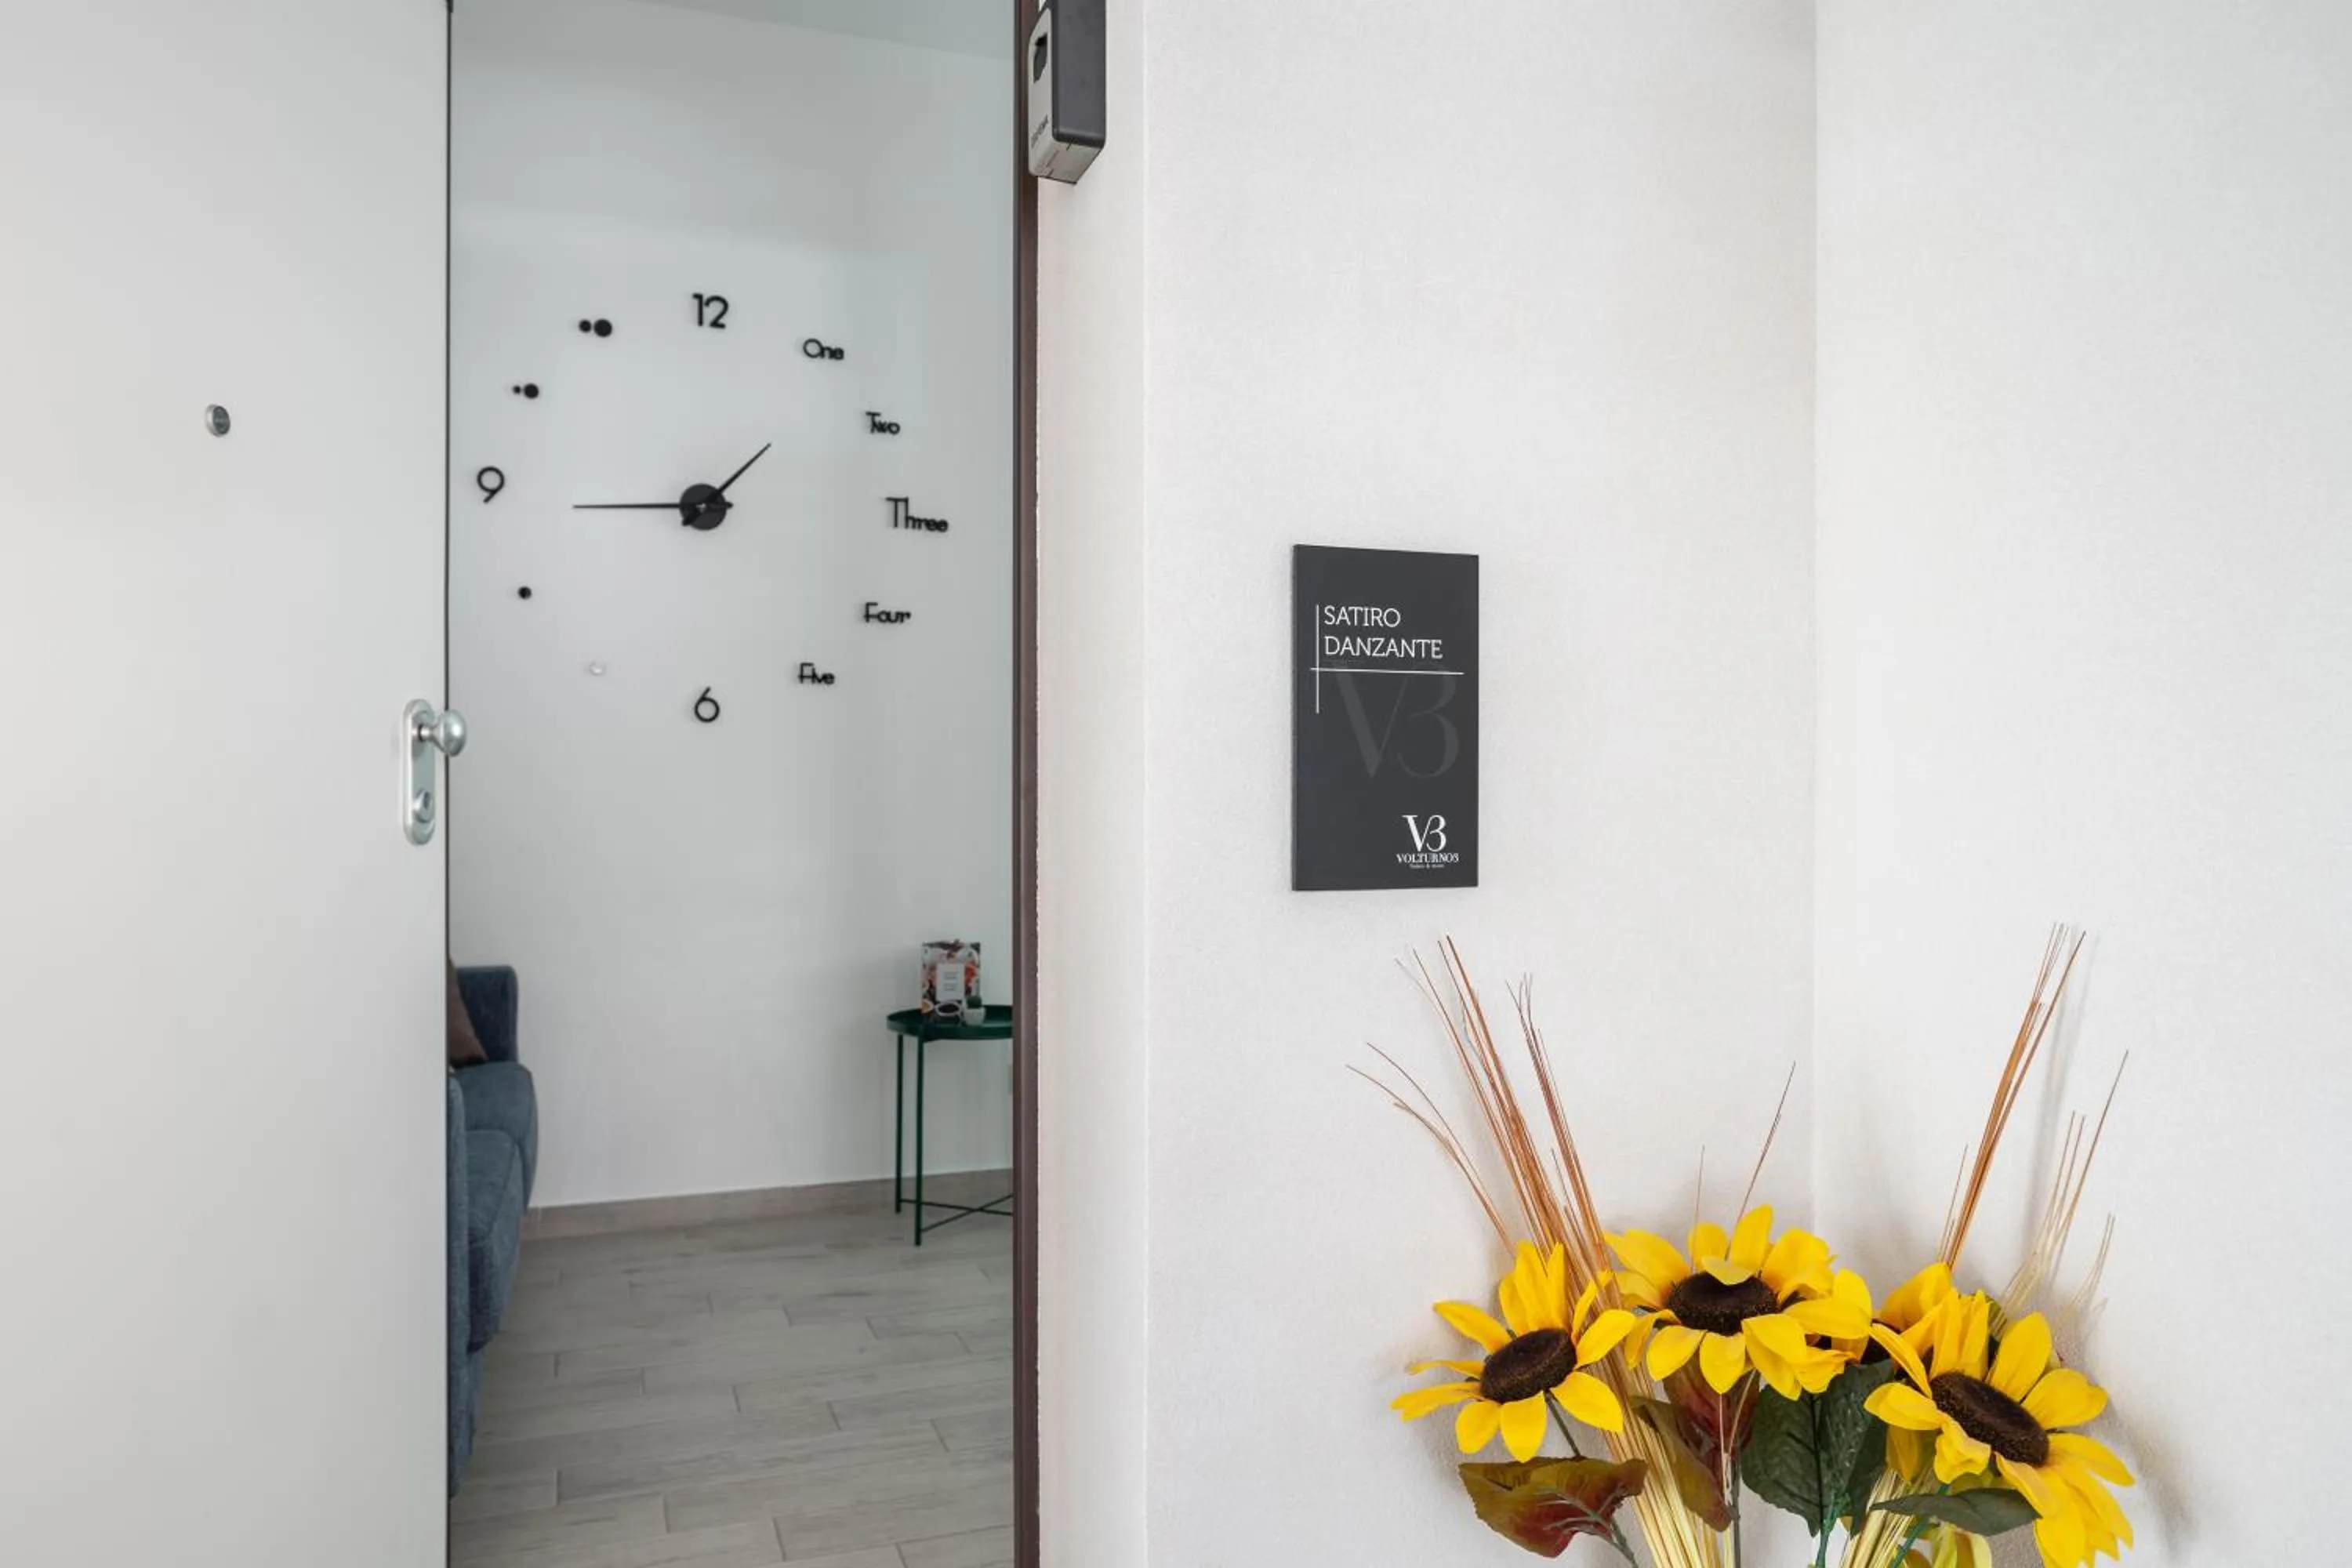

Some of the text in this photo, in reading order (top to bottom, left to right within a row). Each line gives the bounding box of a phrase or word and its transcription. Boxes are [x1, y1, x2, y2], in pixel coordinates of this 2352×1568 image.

[692, 292, 729, 329] 12
[802, 338, 844, 361] One
[864, 410, 901, 435] Two
[476, 466, 505, 503] 9
[885, 496, 949, 533] Three
[862, 601, 912, 624] Four
[1323, 604, 1401, 628] SATIRO
[1323, 635, 1443, 659] DANZANTE
[797, 662, 836, 685] Five
[694, 687, 720, 724] 6
[1401, 814, 1447, 852] V3
